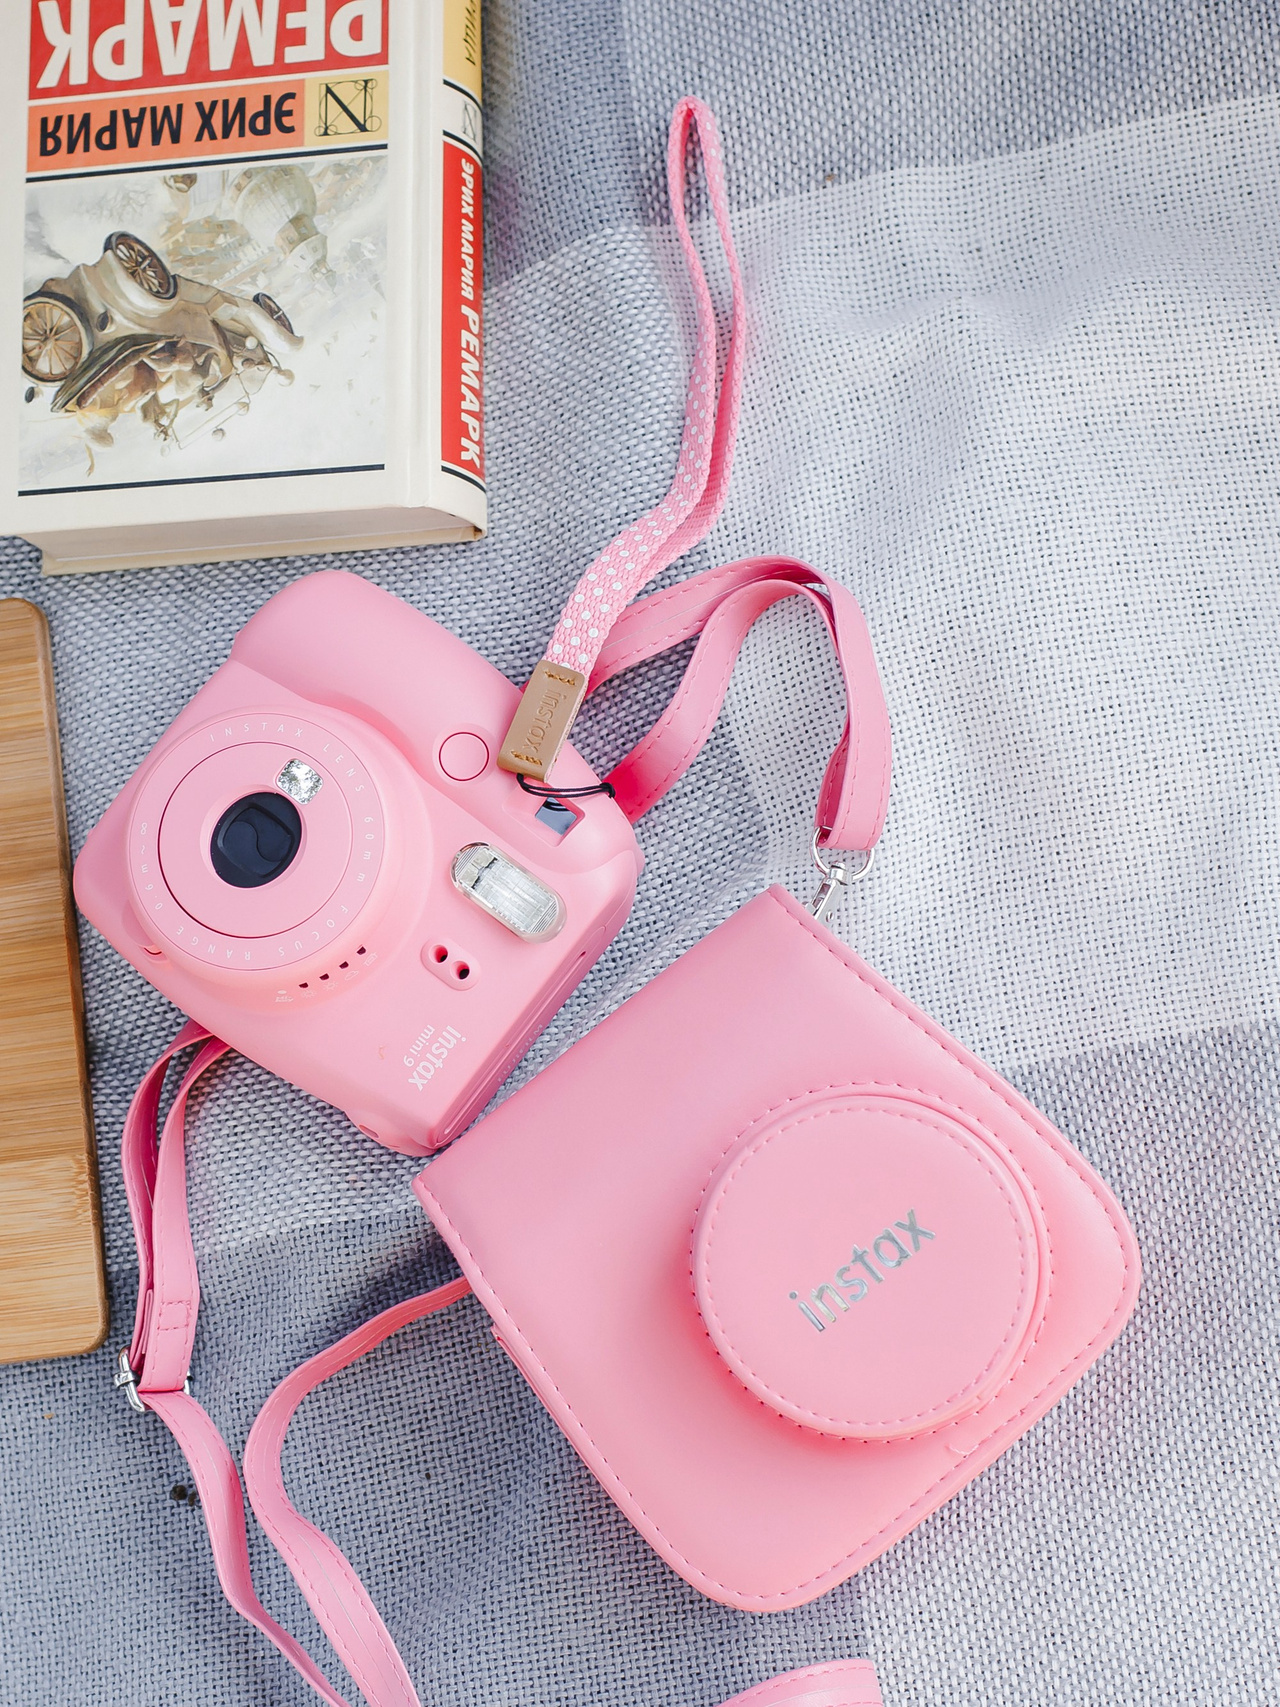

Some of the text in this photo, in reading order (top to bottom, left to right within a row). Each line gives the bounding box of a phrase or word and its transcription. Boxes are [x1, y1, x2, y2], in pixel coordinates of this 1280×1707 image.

[36, 0, 383, 89] РЕМАРК
[38, 92, 297, 157] ЭРИХ МАРИЯ
[460, 157, 481, 468] ЭРИХ МАРИЯ РЕМАРК
[208, 721, 304, 743] INSTAX
[522, 690, 567, 753] instax
[322, 743, 365, 793] LENS
[176, 925, 252, 961] RANGE
[278, 904, 349, 957] FOCUS
[403, 1024, 436, 1067] mini 9
[407, 1025, 467, 1092] instax
[788, 1207, 936, 1333] instax
